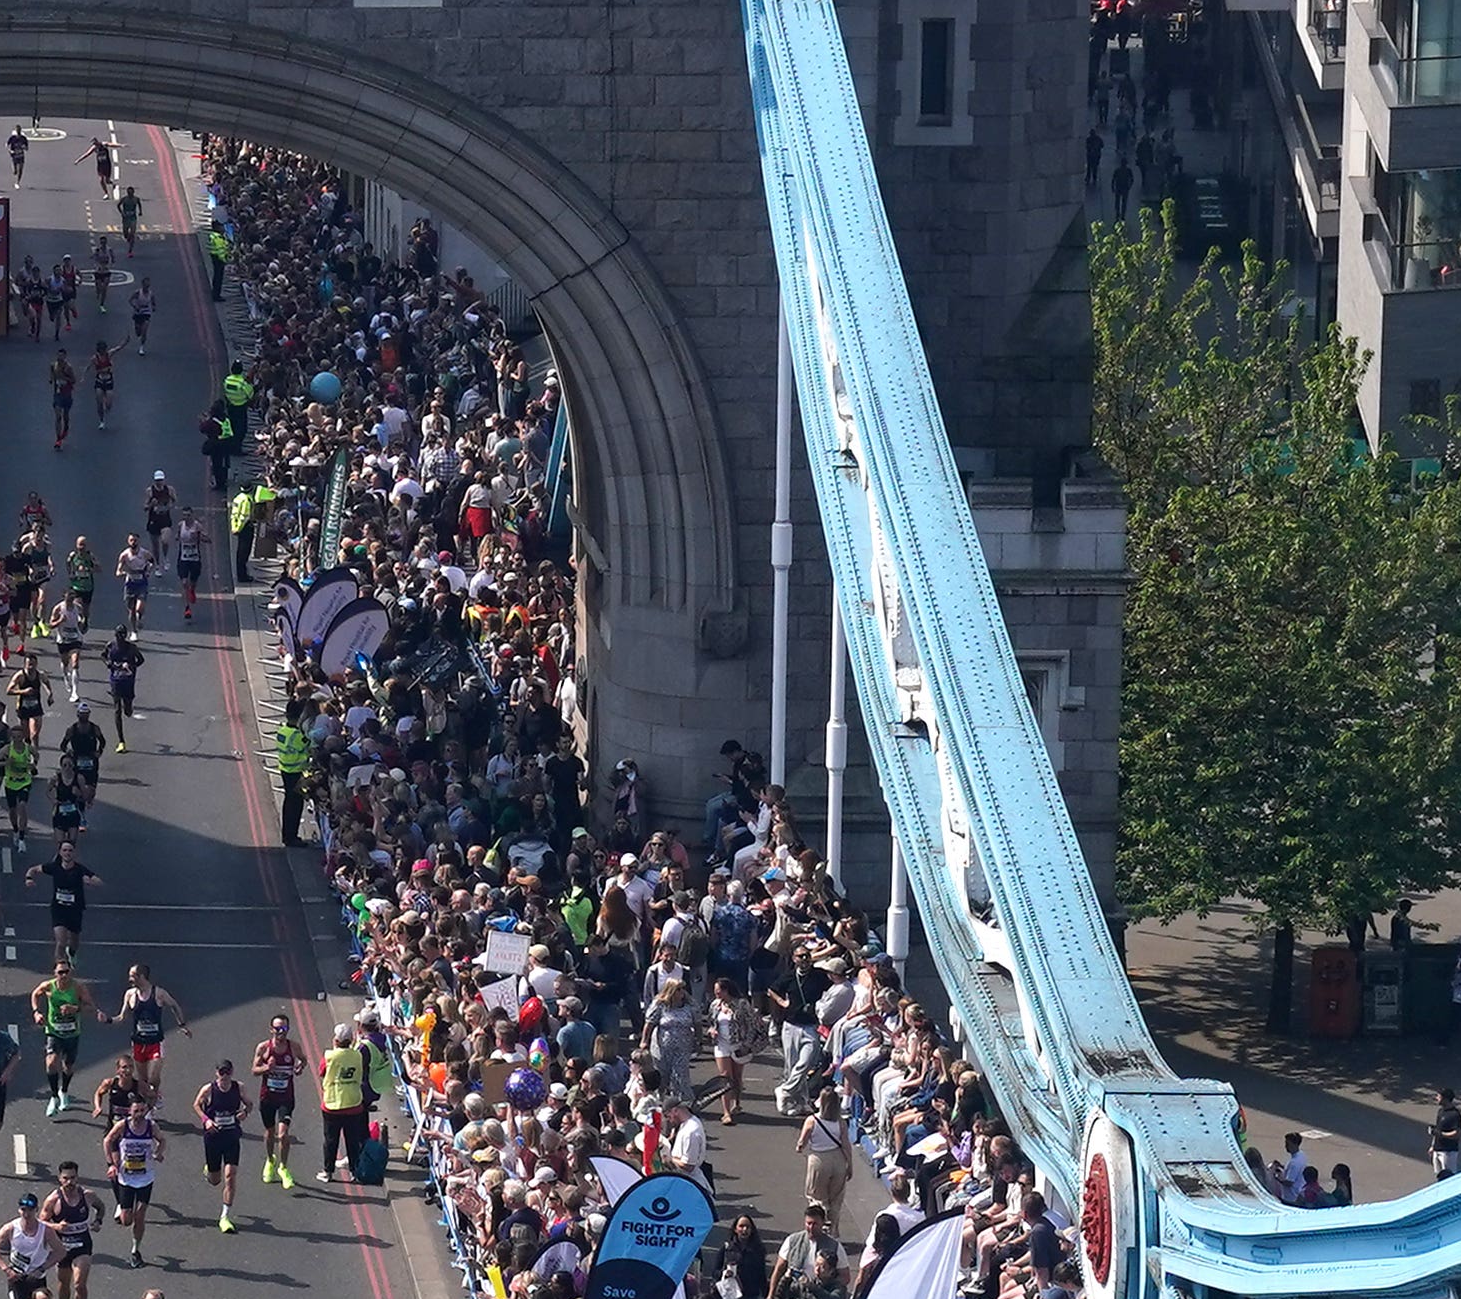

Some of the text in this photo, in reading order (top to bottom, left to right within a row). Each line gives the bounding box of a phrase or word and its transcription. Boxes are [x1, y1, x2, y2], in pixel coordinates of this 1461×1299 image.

[326, 463, 346, 530] RUNNERS
[323, 531, 337, 570] EGAN
[621, 1220, 695, 1238] FIGHT FOR
[634, 1234, 680, 1249] SIGHT
[602, 1285, 637, 1299] Save
